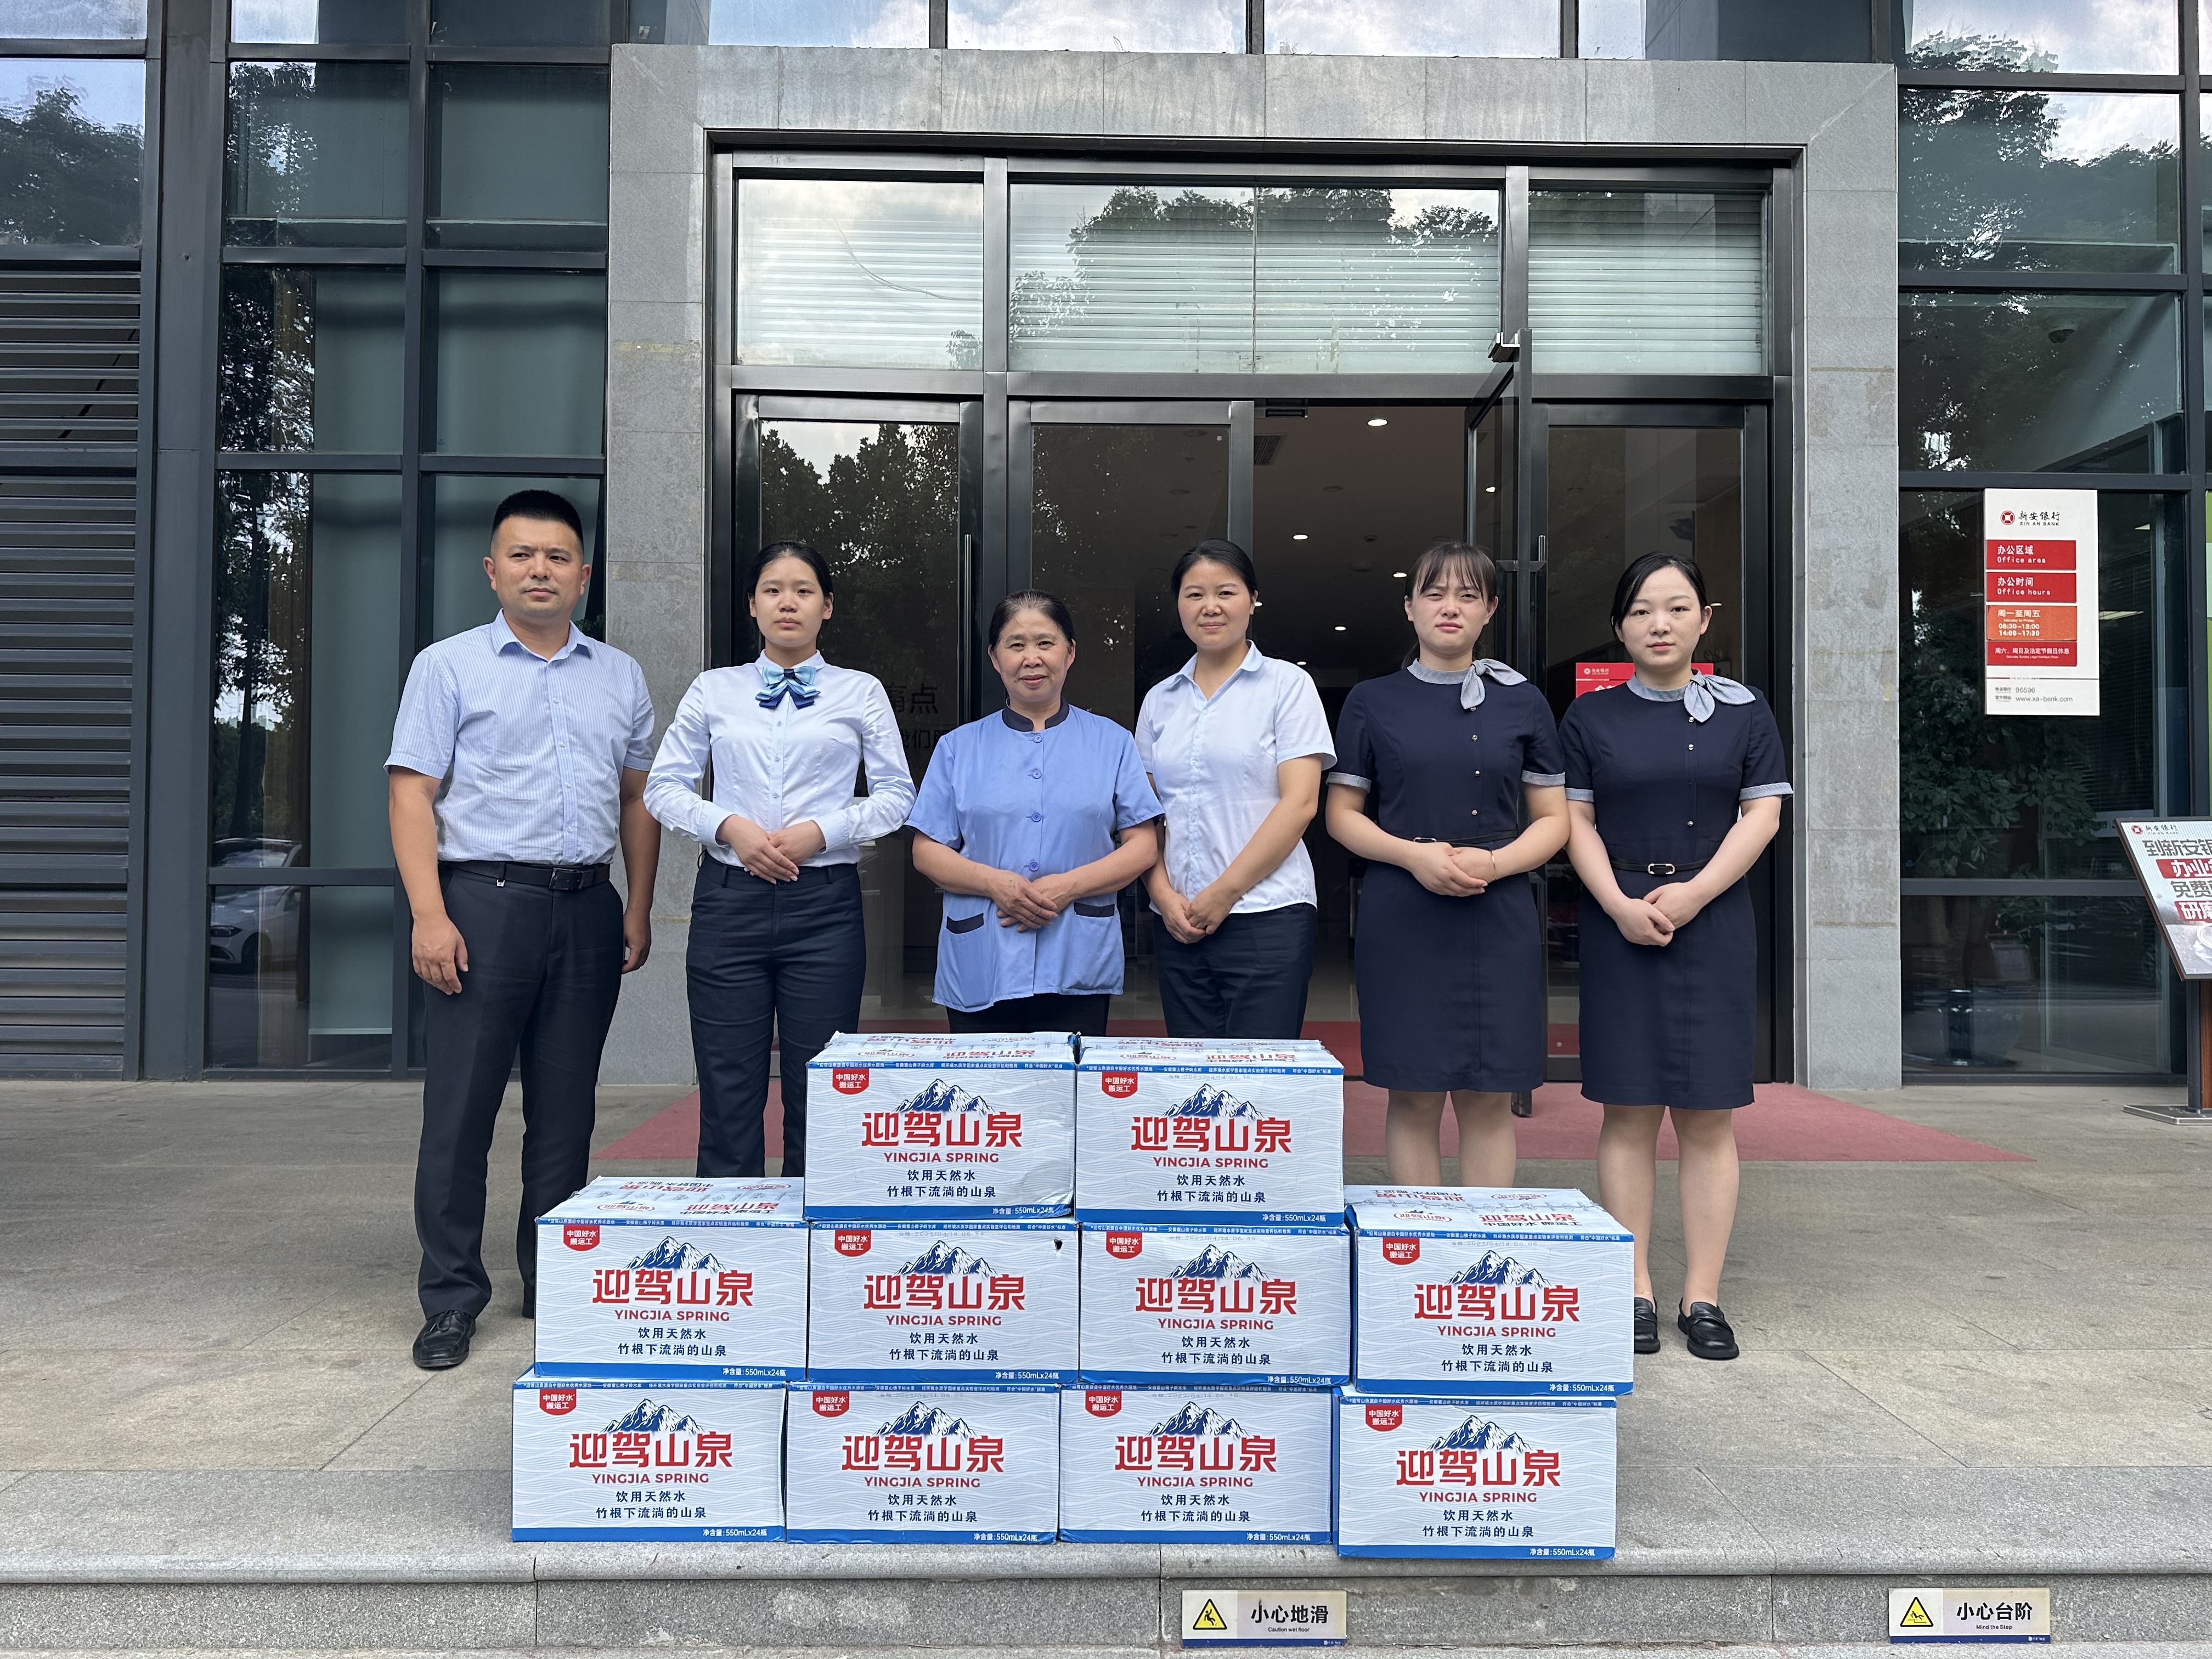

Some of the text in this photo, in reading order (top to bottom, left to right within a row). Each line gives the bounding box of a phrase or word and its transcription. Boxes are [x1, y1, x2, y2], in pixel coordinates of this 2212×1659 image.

[2018, 511, 2060, 521] 新安银行
[1997, 545, 2034, 555] 办公区域
[1997, 577, 2034, 586] 办公时间
[1997, 610, 2040, 618] 周一至周五
[2171, 859, 2212, 877] 办业
[2170, 881, 2212, 898] 免费
[836, 1073, 866, 1081] 中国好水
[1104, 1077, 1135, 1085] 中国好水
[1108, 1085, 1131, 1093] 搬运工
[862, 1112, 1021, 1147] 迎驾山泉
[1131, 1116, 1290, 1153] 迎驾山泉
[884, 1153, 999, 1163] YINGJIA SPRING
[1153, 1156, 1268, 1169] YINGJIA SPRING
[907, 1170, 975, 1181] 饮用天然水
[1177, 1174, 1245, 1187] 饮用天然水
[887, 1185, 996, 1198] 竹根下流淌的山泉
[1157, 1189, 1266, 1203] 竹根下流淌的山泉
[567, 1229, 597, 1238] 中国好水
[838, 1235, 868, 1243] 中国好水
[1109, 1238, 1139, 1246] 中国好水
[1385, 1243, 1417, 1251] 中国好水
[1389, 1251, 1413, 1259] 搬运工
[592, 1269, 752, 1305] 迎驾山泉
[864, 1274, 1024, 1310] 迎驾山泉
[1136, 1278, 1295, 1314] 迎驾山泉
[1415, 1284, 1578, 1321] 迎驾山泉
[615, 1310, 730, 1322] YINGJIA SPRING
[886, 1315, 1002, 1327] YINGJIA SPRING
[1158, 1318, 1273, 1331] YINGJIA SPRING
[638, 1327, 707, 1340] 饮用天然水
[1437, 1325, 1555, 1339] YINGJIA SPRING
[910, 1332, 978, 1345] 饮用天然水
[1182, 1336, 1250, 1348] 饮用天然水
[618, 1342, 727, 1356] 竹根下流淌的山泉
[889, 1348, 999, 1361] 竹根下流淌的山泉
[1462, 1343, 1532, 1357] 饮用天然水
[1161, 1351, 1271, 1365] 竹根下流淌的山泉
[1442, 1359, 1553, 1373] 竹根下流淌的山泉
[816, 1396, 846, 1404] 中国好水
[1088, 1396, 1119, 1404] 中国好水
[1368, 1409, 1399, 1418] 中国好水
[1372, 1418, 1396, 1426] 搬运工
[569, 1431, 731, 1468] 迎驾山泉
[842, 1435, 1002, 1471] 迎驾山泉
[1115, 1436, 1275, 1471] 迎驾山泉
[1397, 1449, 1559, 1486] 迎驾山泉
[592, 1473, 709, 1483] YINGJIA SPRING
[865, 1476, 980, 1488] YINGJIA SPRING
[1137, 1476, 1253, 1488] YINGJIA SPRING
[616, 1491, 686, 1502] 饮用天然水
[888, 1494, 957, 1506] 饮用天然水
[1161, 1494, 1230, 1506] 饮用天然水
[1419, 1492, 1536, 1503] YINGJIA SPRING
[596, 1507, 707, 1518] 竹根下流淌的山泉
[868, 1509, 978, 1522] 竹根下流淌的山泉
[1141, 1510, 1251, 1522] 竹根下流淌的山泉
[1443, 1509, 1513, 1521] 饮用天然水
[1423, 1525, 1534, 1538] 竹根下流淌的山泉
[1251, 1605, 1328, 1624] 小心地滑
[1956, 1602, 2032, 1621] 小心台阶
